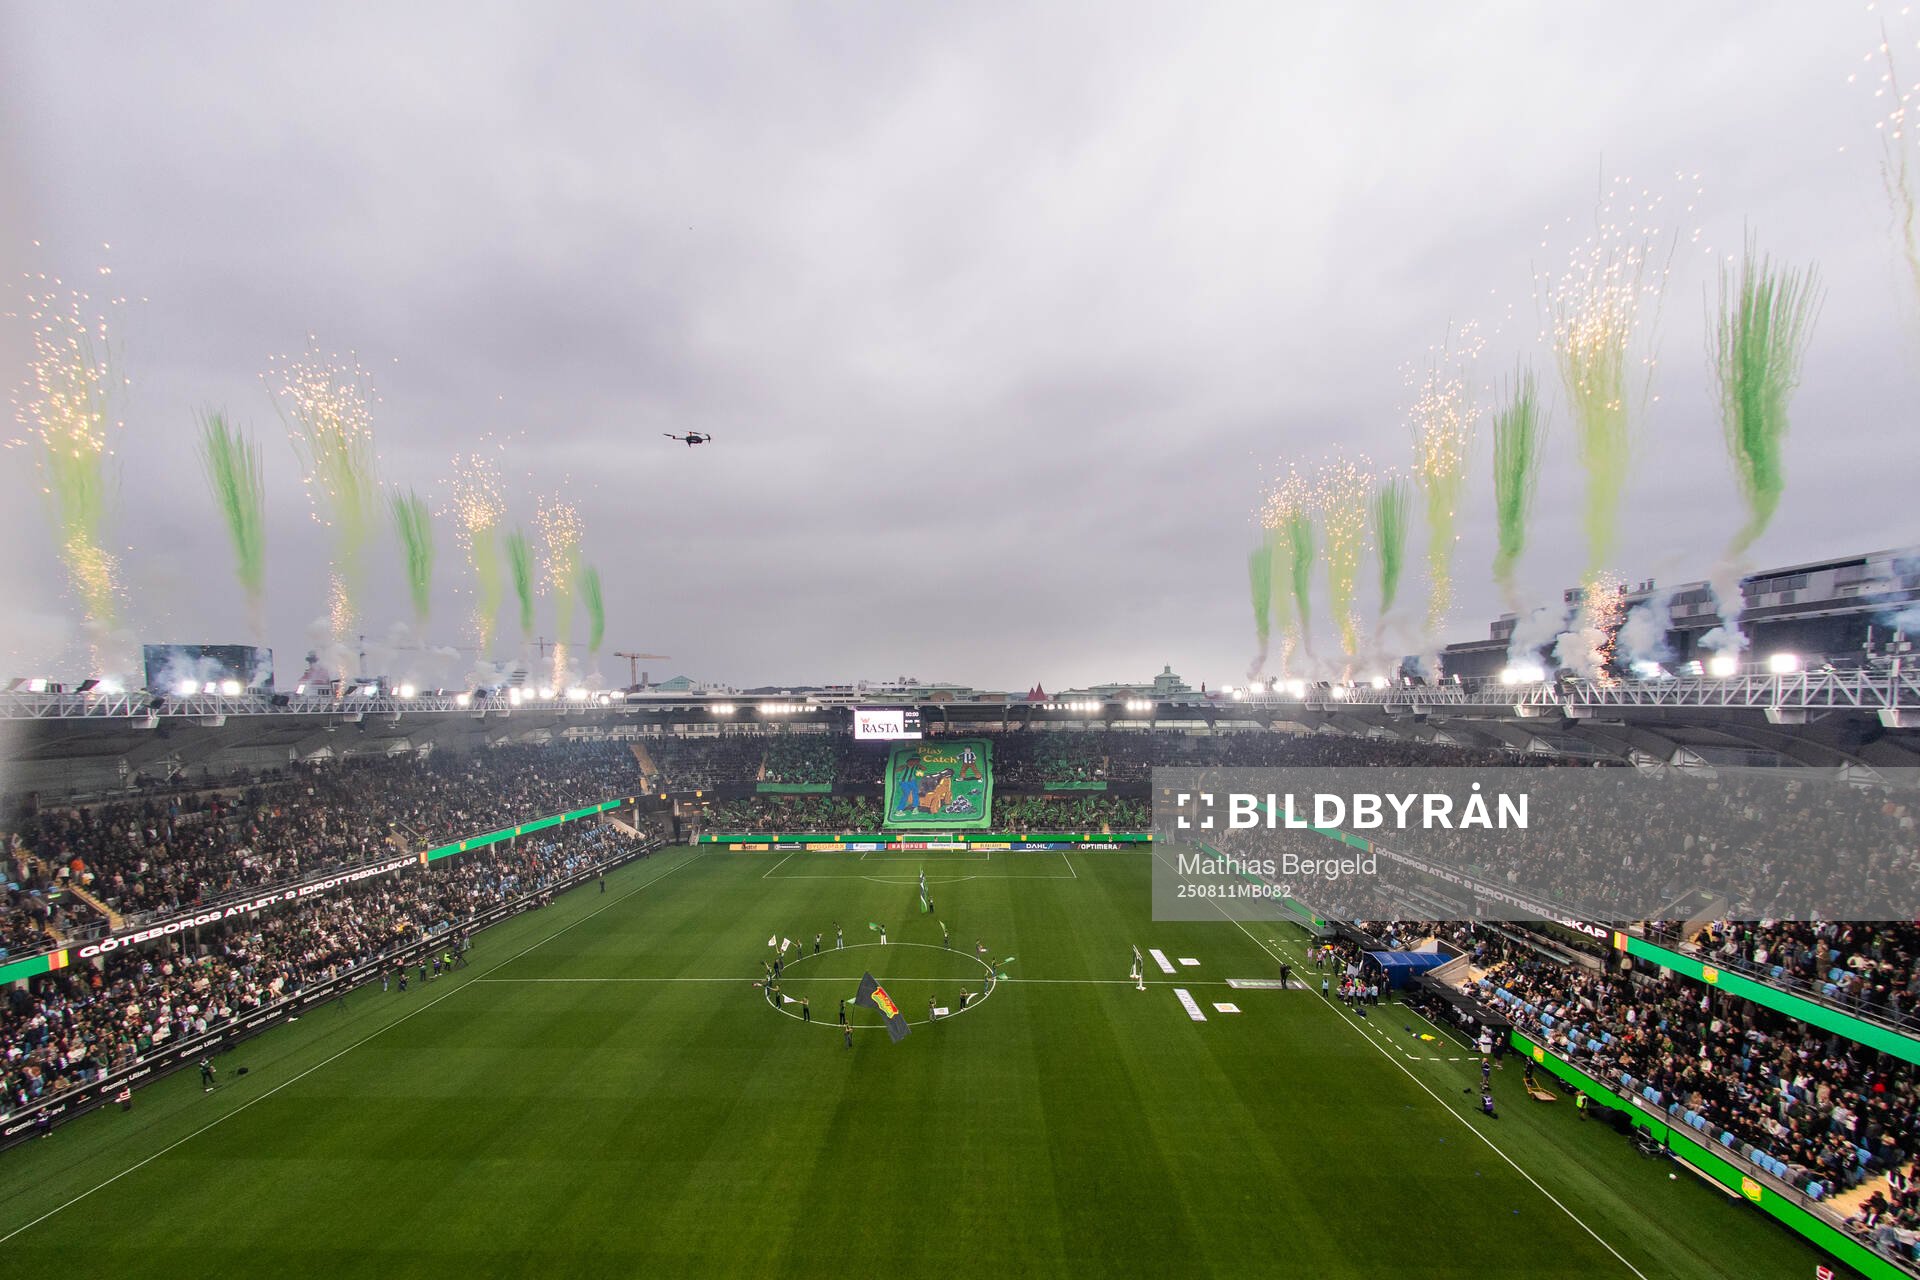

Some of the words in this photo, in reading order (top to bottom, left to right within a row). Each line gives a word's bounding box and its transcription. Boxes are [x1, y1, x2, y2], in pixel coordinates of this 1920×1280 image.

[862, 724, 899, 733] RASTA
[923, 755, 958, 764] Catch
[1375, 847, 1429, 873] GÖTEBORGS
[79, 911, 221, 958] GÖTEBORGS
[224, 894, 283, 918] ATLET-
[285, 890, 296, 900] &
[101, 1078, 128, 1093] Gamla
